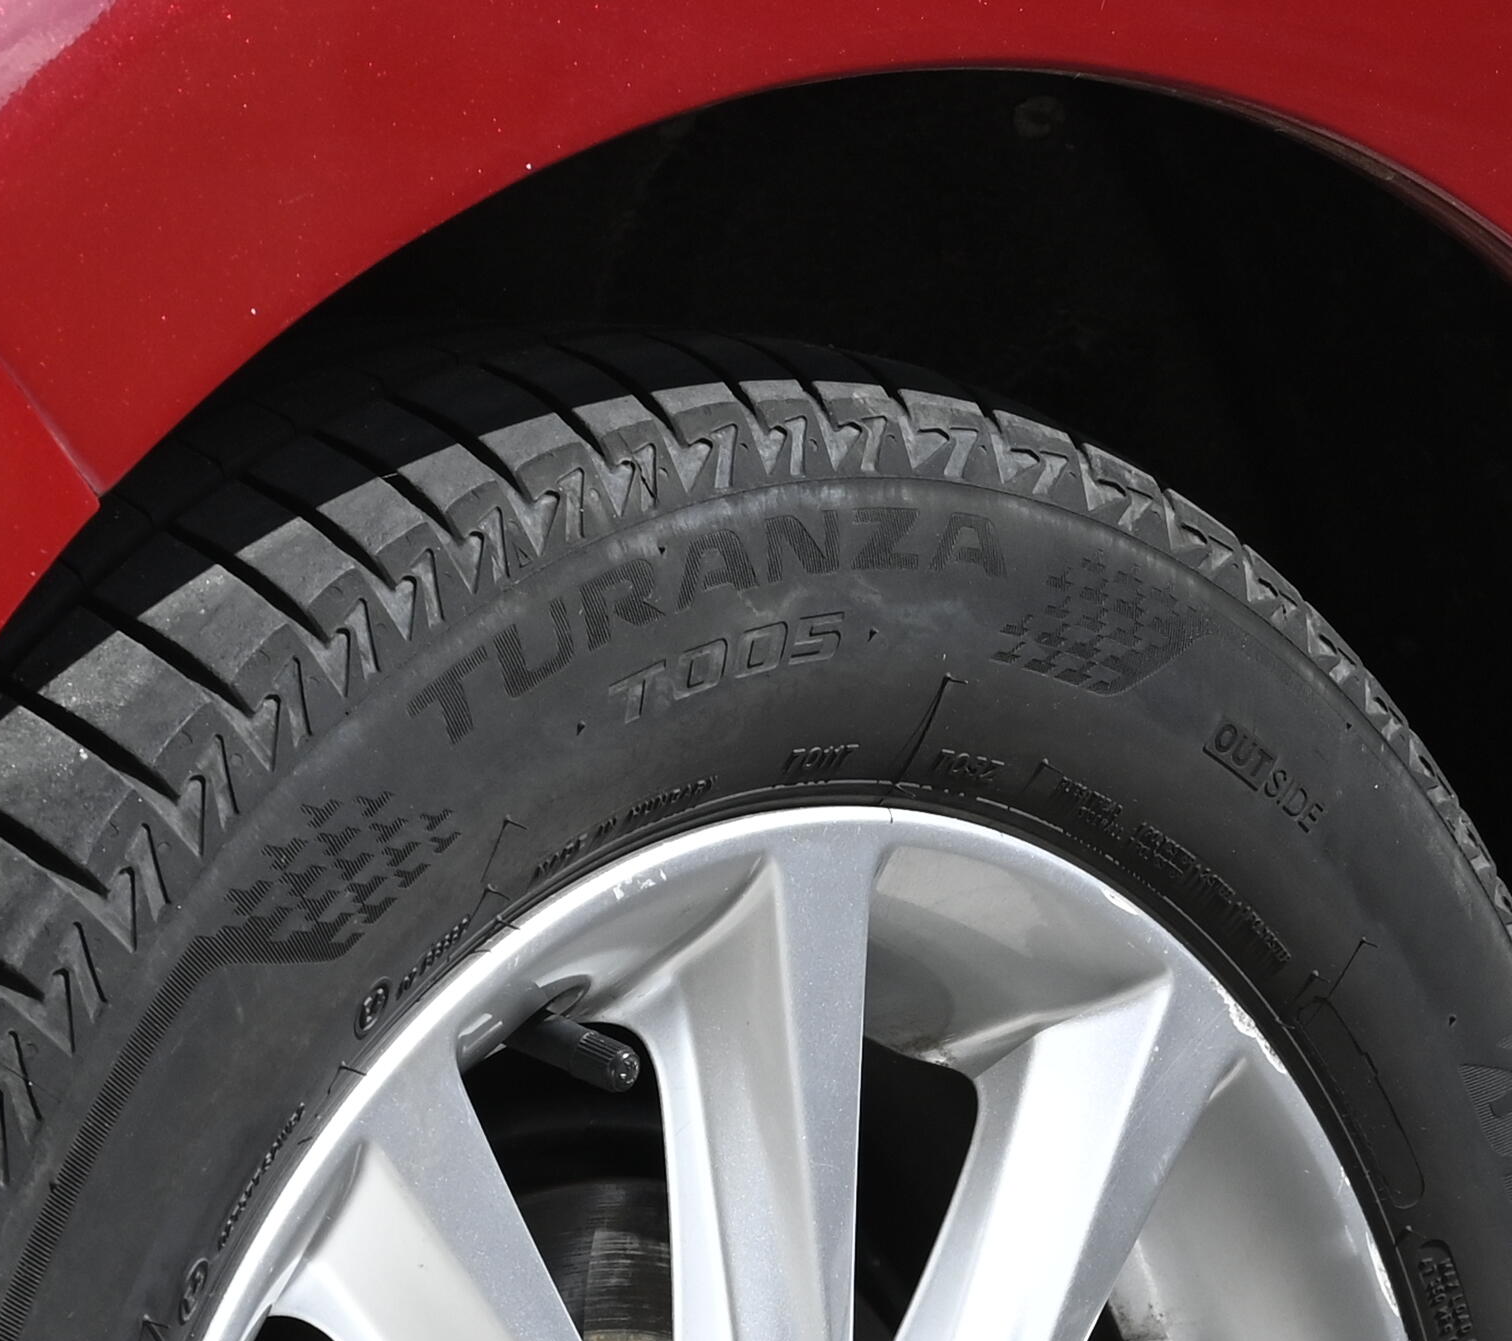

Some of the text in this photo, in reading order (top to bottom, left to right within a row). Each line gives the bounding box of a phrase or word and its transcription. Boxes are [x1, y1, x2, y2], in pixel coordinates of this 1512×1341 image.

[406, 507, 1008, 745] TURANZA
[608, 611, 845, 725] T005
[1205, 722, 1325, 834] OUTSIDE
